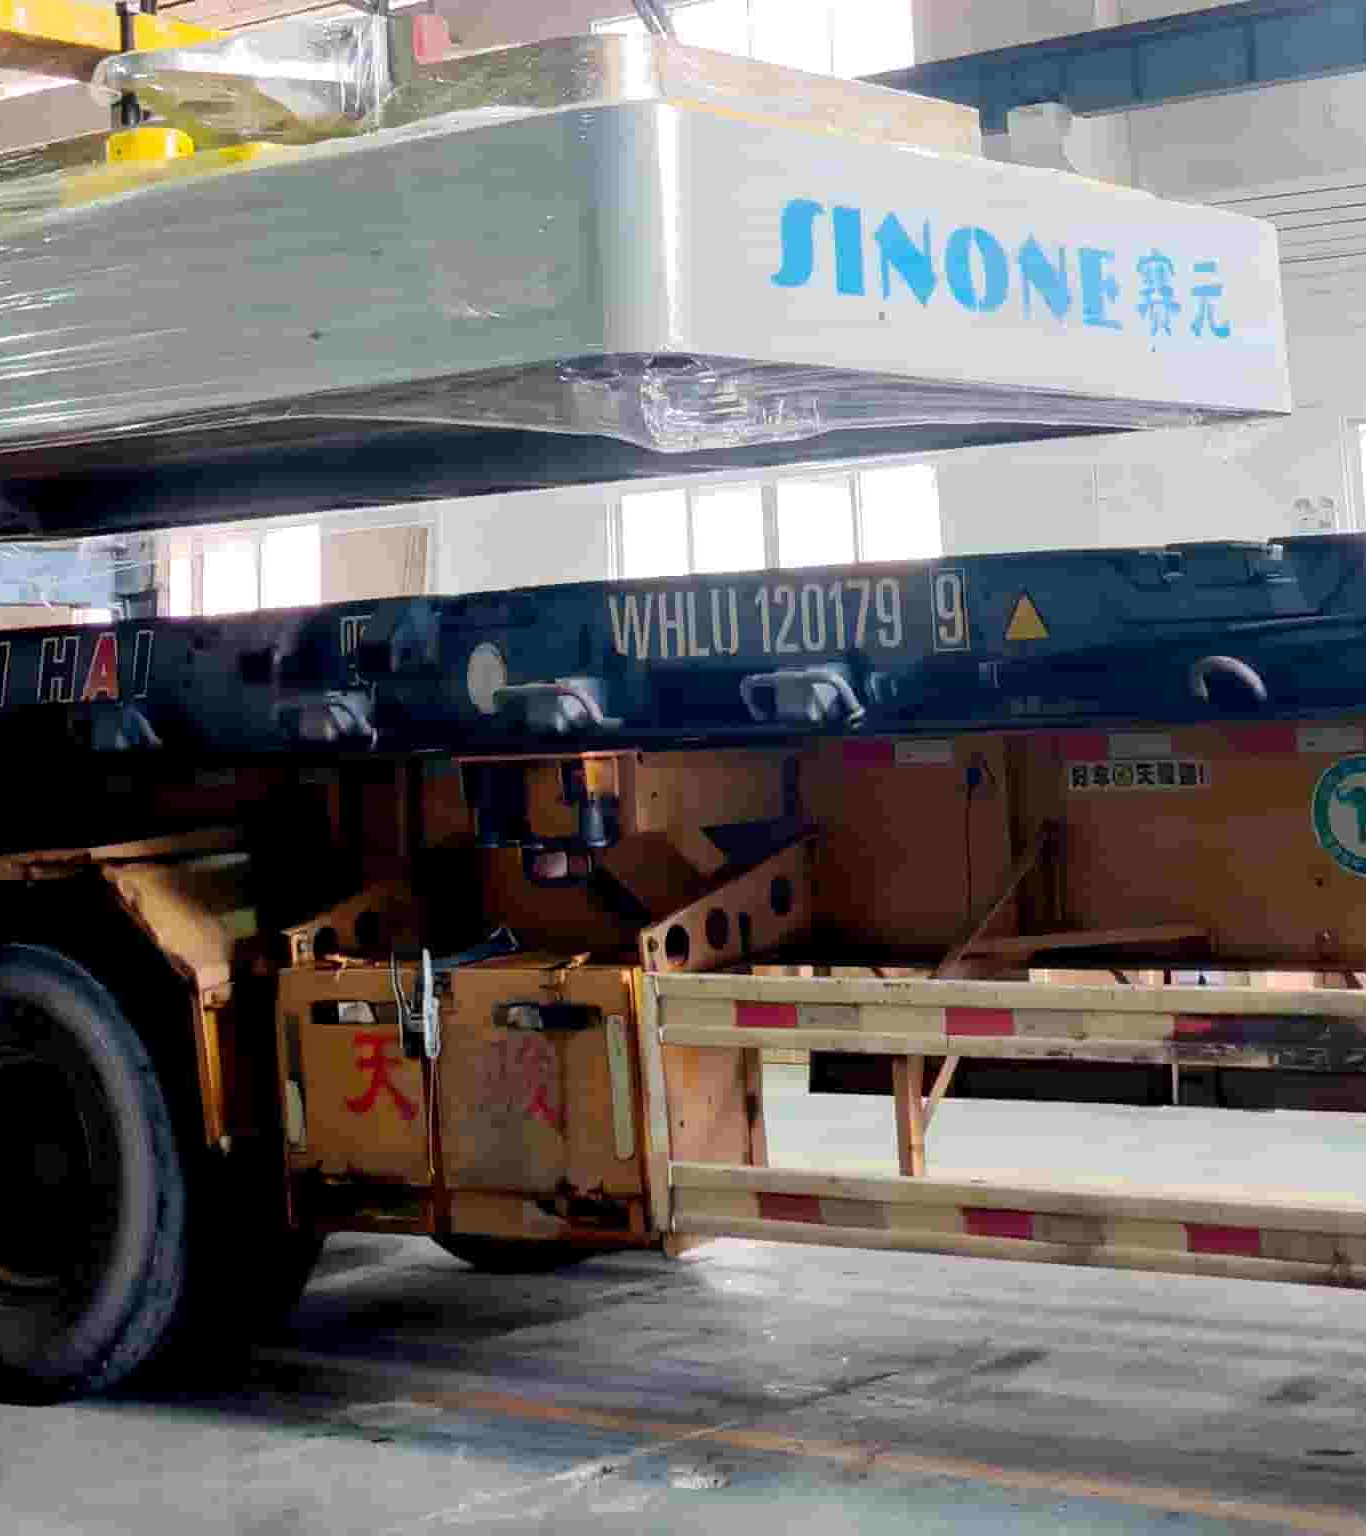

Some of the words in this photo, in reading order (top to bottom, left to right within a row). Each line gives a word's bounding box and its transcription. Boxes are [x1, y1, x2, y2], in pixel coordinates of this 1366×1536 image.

[770, 197, 1124, 331] SINONE
[1136, 247, 1232, 338] 赛元
[608, 586, 740, 661] WHLU
[754, 576, 903, 654] 120179
[935, 571, 966, 646] 9
[37, 630, 155, 704] HAI
